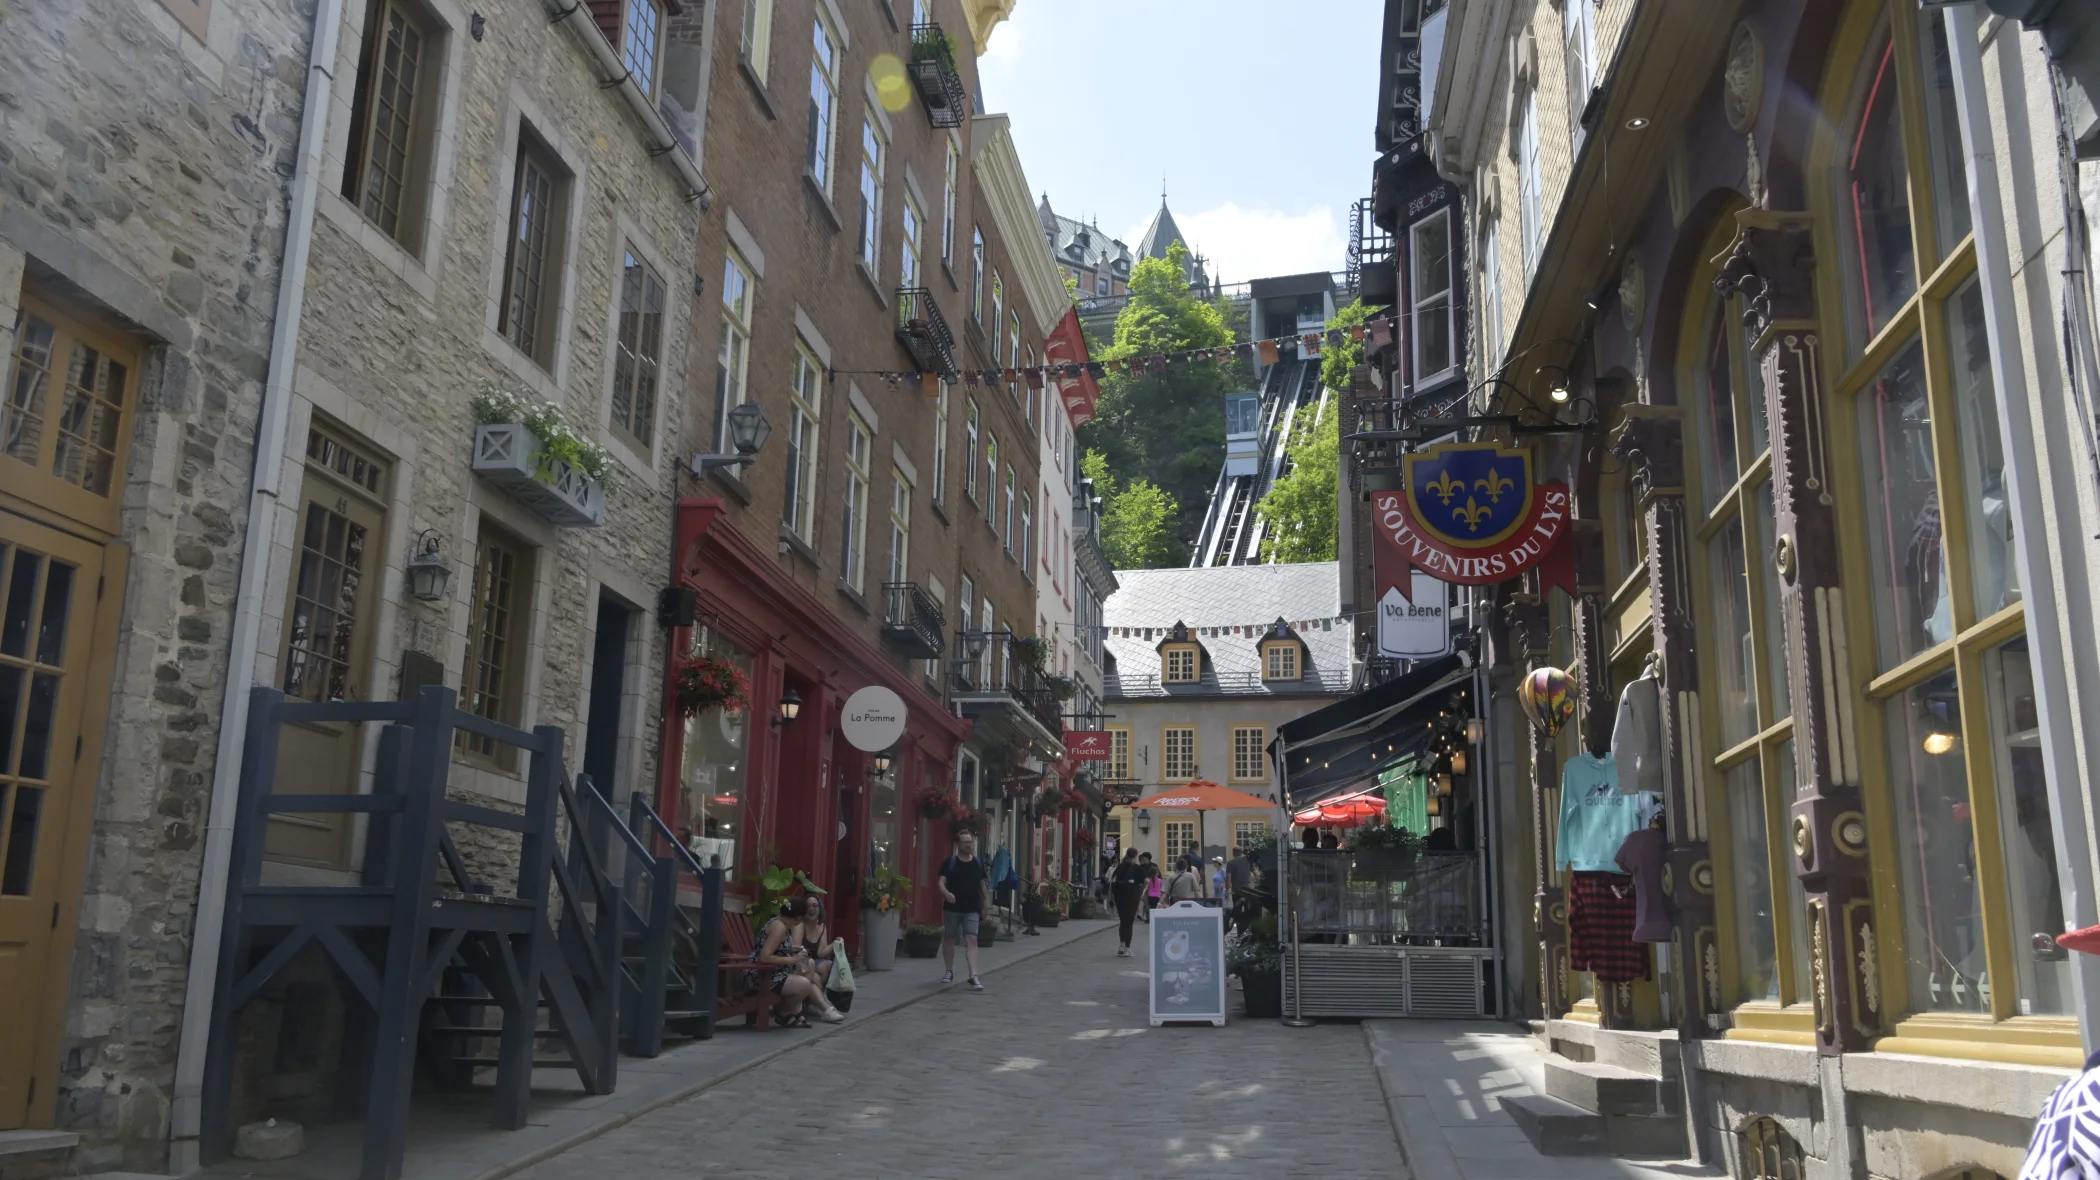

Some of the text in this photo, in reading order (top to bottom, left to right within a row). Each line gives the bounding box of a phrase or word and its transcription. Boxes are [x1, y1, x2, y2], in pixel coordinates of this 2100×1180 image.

[1378, 491, 1566, 577] SOUVENIRS DU LYS
[1385, 604, 1442, 617] Va Bene
[851, 713, 895, 722] La Pomme
[1071, 747, 1105, 755] Fluchos
